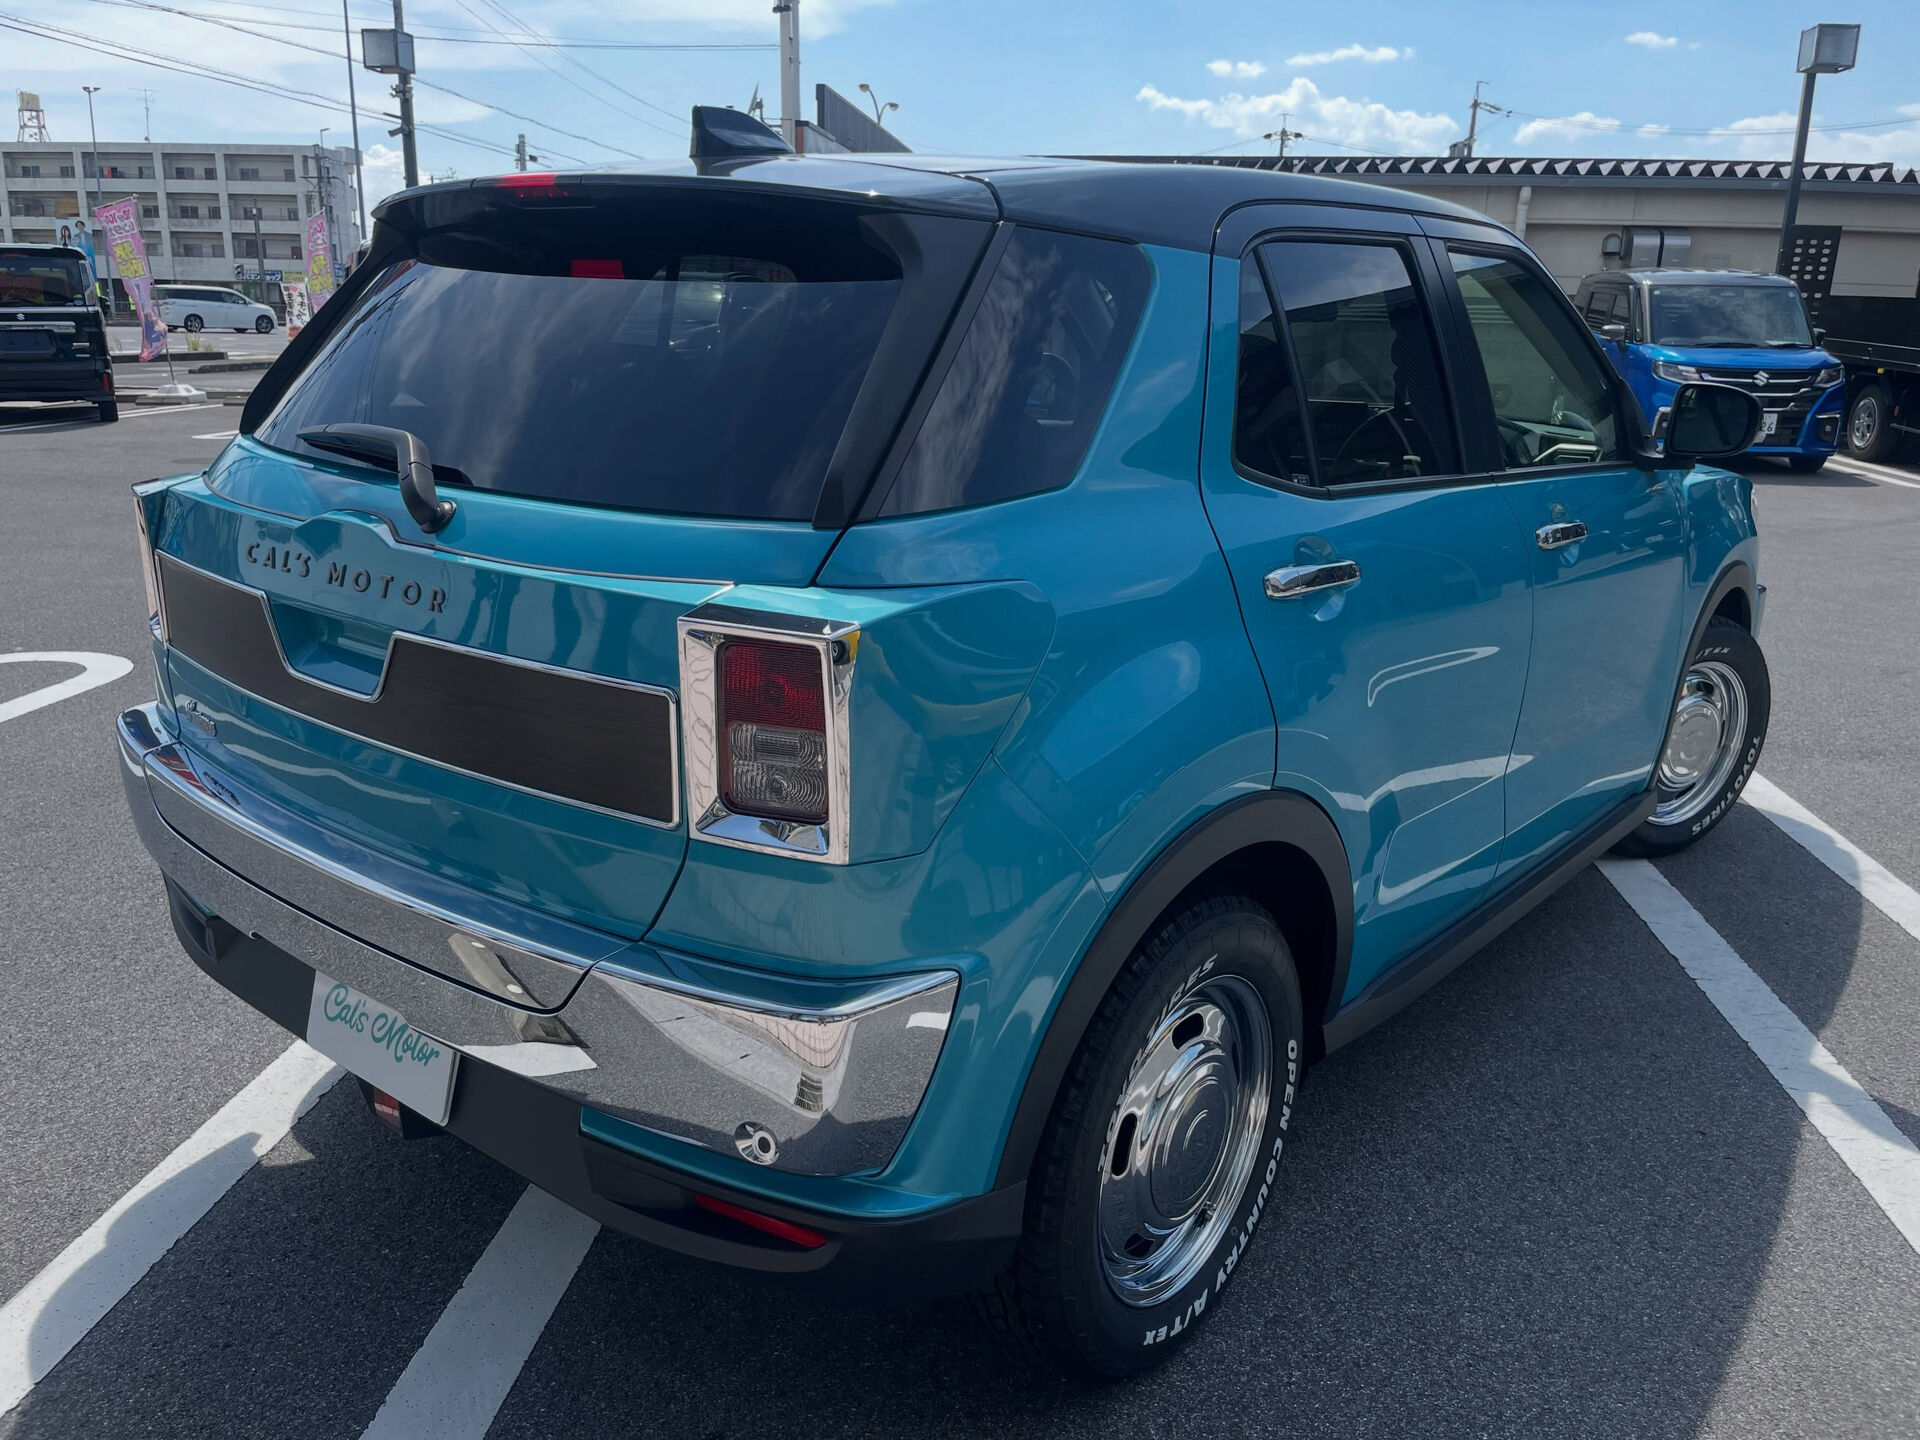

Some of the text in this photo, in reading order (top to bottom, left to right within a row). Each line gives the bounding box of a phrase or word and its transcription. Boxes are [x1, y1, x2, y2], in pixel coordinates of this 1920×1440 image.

[247, 542, 446, 613] CAL'S MOTOR
[1691, 735, 1760, 836] TOYO TIRES
[324, 983, 440, 1067] Cal's Motor
[1145, 953, 1218, 1041] TIRES
[1278, 1039, 1298, 1132] OPEN
[1214, 1137, 1284, 1293] COUNTRY
